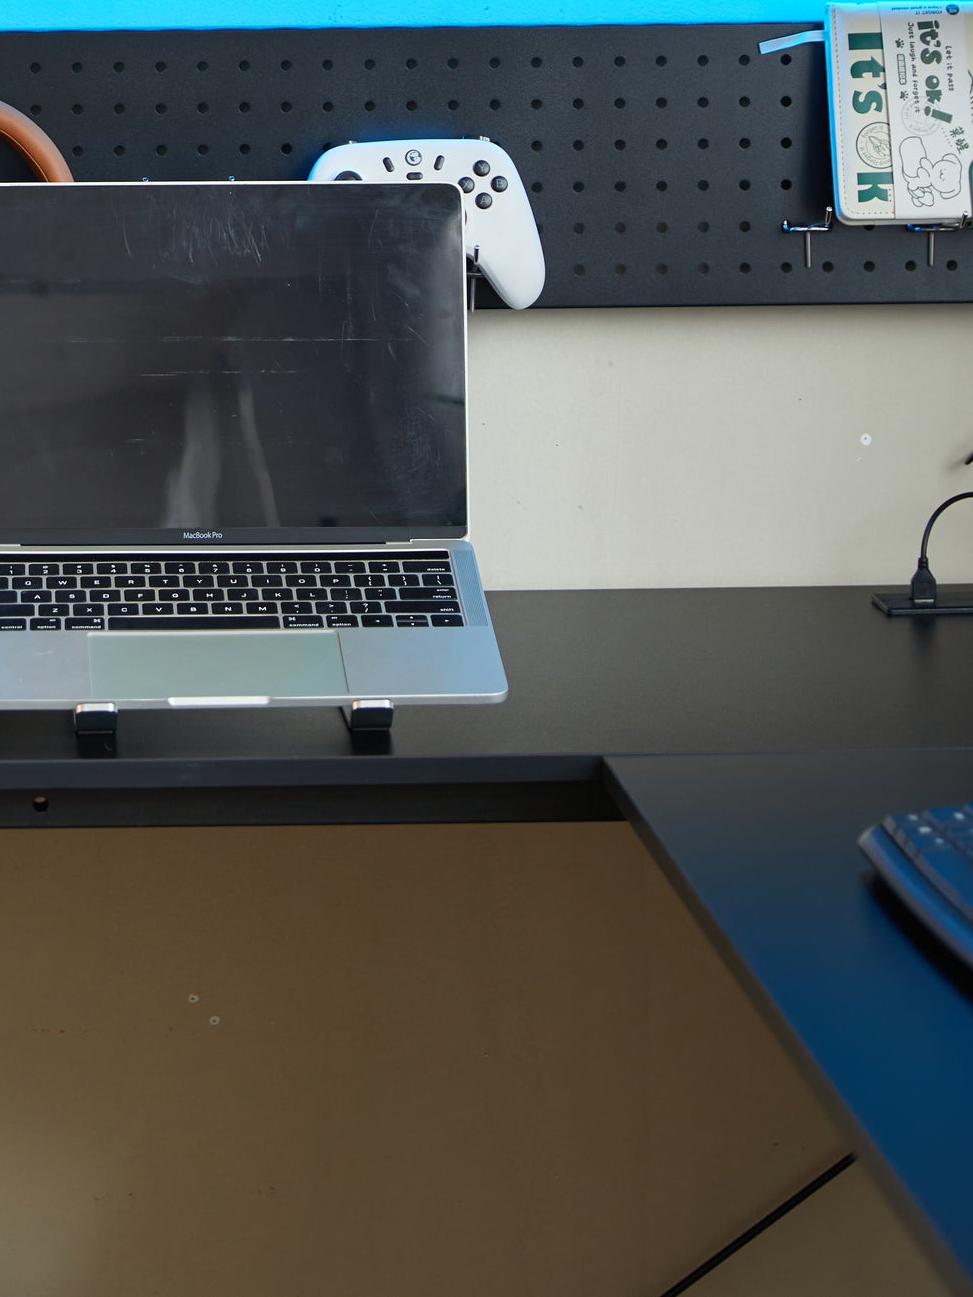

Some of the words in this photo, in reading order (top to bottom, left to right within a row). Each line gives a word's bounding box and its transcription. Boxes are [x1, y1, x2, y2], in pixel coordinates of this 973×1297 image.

[909, 42, 917, 62] laugh
[479, 164, 486, 173] Y
[496, 179, 503, 188] B
[479, 196, 487, 205] A
